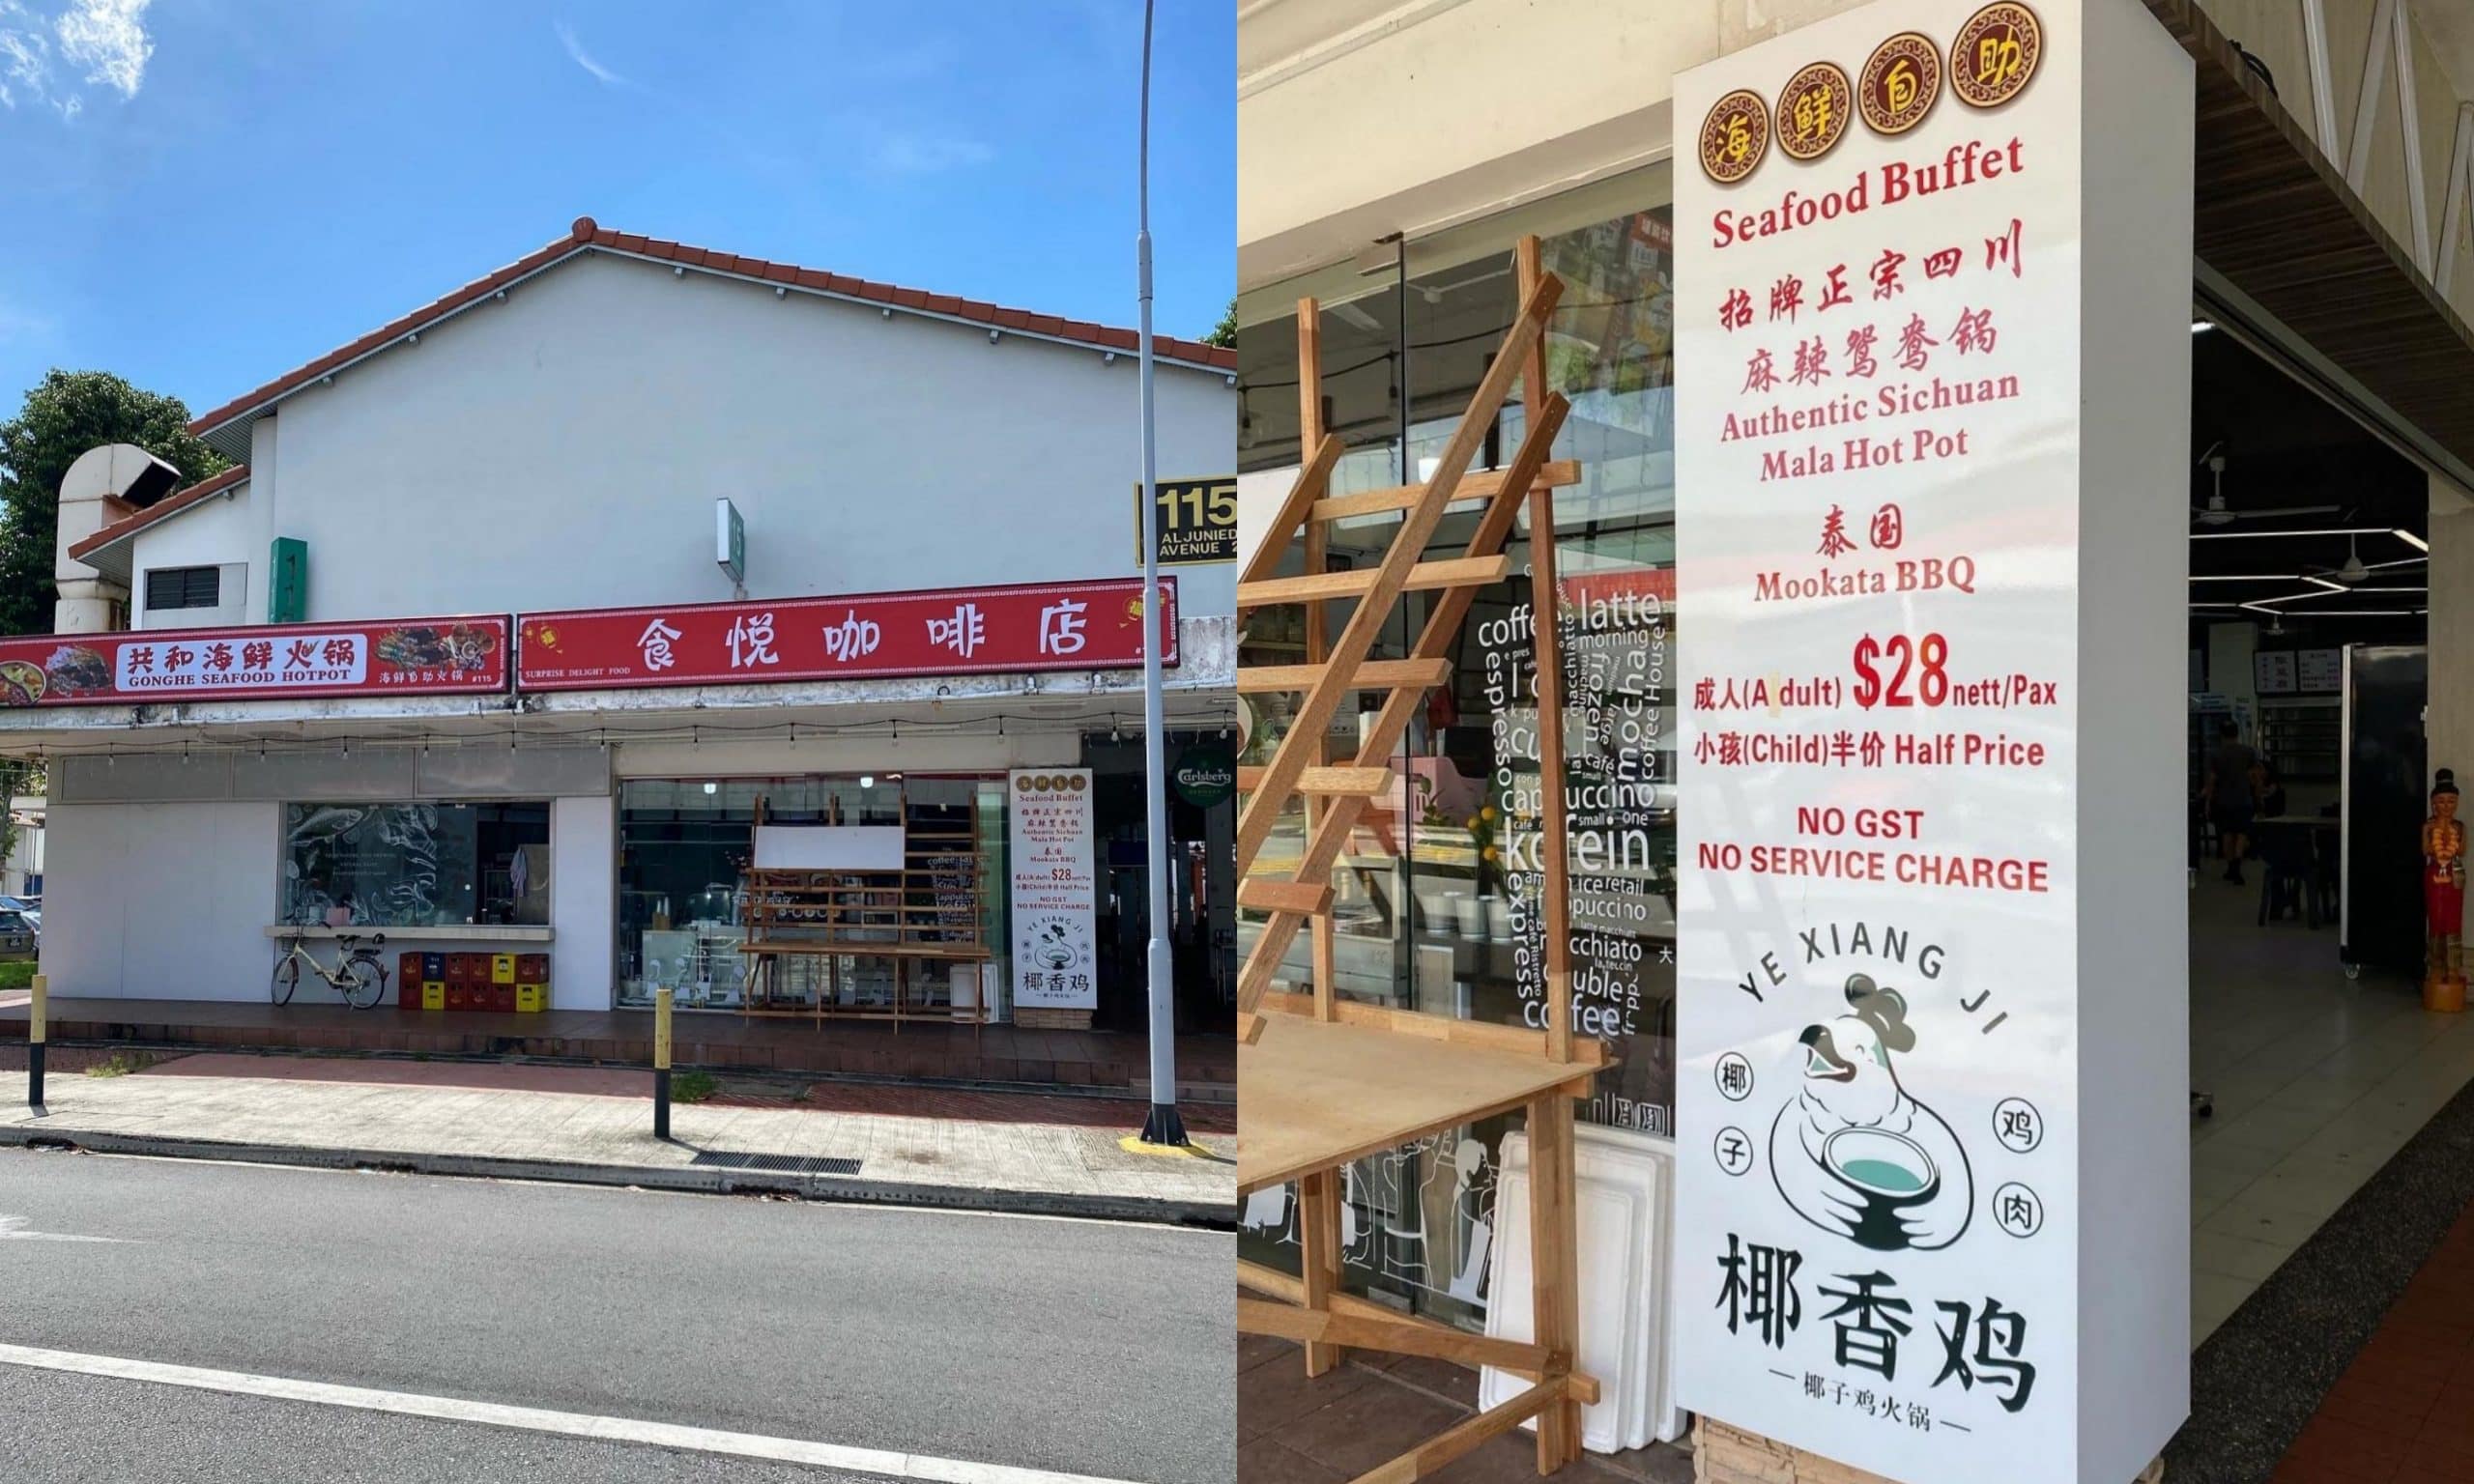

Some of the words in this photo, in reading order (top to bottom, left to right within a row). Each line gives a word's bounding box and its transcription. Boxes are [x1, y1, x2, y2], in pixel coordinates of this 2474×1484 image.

[1712, 171, 1870, 249] Seafood
[1881, 136, 2025, 205] Buffet
[1718, 218, 2024, 333] 招牌正宗四川
[1720, 392, 1868, 443] Authentic
[1878, 373, 2019, 417] Sichuan
[1760, 445, 1835, 482] Mala
[1843, 436, 1904, 471] Hot
[1913, 427, 1969, 461] Pot
[1157, 485, 1237, 529] 115
[1159, 542, 1221, 556] AVENUE
[1162, 528, 1237, 545] ALJUNIED
[1816, 502, 1903, 560] 泰国
[1754, 568, 1885, 603] Mookata
[1895, 556, 1975, 595] BBQ
[1580, 587, 1661, 631] latte
[636, 597, 1089, 671] 食悦咖啡店
[1579, 626, 1649, 650] morning
[127, 639, 356, 675] 共和海鲜火锅
[129, 673, 195, 688] GONGHE
[201, 671, 275, 686] SEAFOOD
[281, 669, 351, 682] HOTPOT
[525, 669, 565, 679] SURPRISE
[568, 668, 604, 677] DELIGHT
[608, 666, 631, 675] FOOD
[1644, 625, 1666, 701] House
[1853, 632, 1949, 713] $28
[1952, 673, 2058, 710] nett/Pax
[1483, 651, 1513, 787] espresso
[1585, 652, 1611, 743] frozen
[1617, 649, 1647, 782] mocha
[1599, 703, 1622, 746] large
[1640, 707, 1660, 781] coffee
[1585, 754, 1615, 775] café
[1895, 733, 1956, 766] Half
[1963, 732, 2046, 767] Price
[1177, 768, 1232, 787] Carlsberg
[1577, 813, 1605, 827] small
[1622, 811, 1649, 826] one
[1797, 806, 1845, 837] NO
[1855, 808, 1925, 841] GST
[1051, 869, 1072, 881] $28
[1577, 872, 1603, 895] ice
[1605, 875, 1645, 898] retail
[1698, 842, 1741, 871] NO
[1750, 845, 1885, 882] SERVICE
[1895, 853, 2049, 894] CHARGE
[1507, 872, 1535, 999] express
[1739, 950, 1787, 1004] YE
[1798, 921, 1945, 981] XIANG
[1960, 988, 2008, 1036] JI
[1714, 1232, 2036, 1414] 椰香鸡
[1802, 1369, 1932, 1434] 椰子鸡火锅
